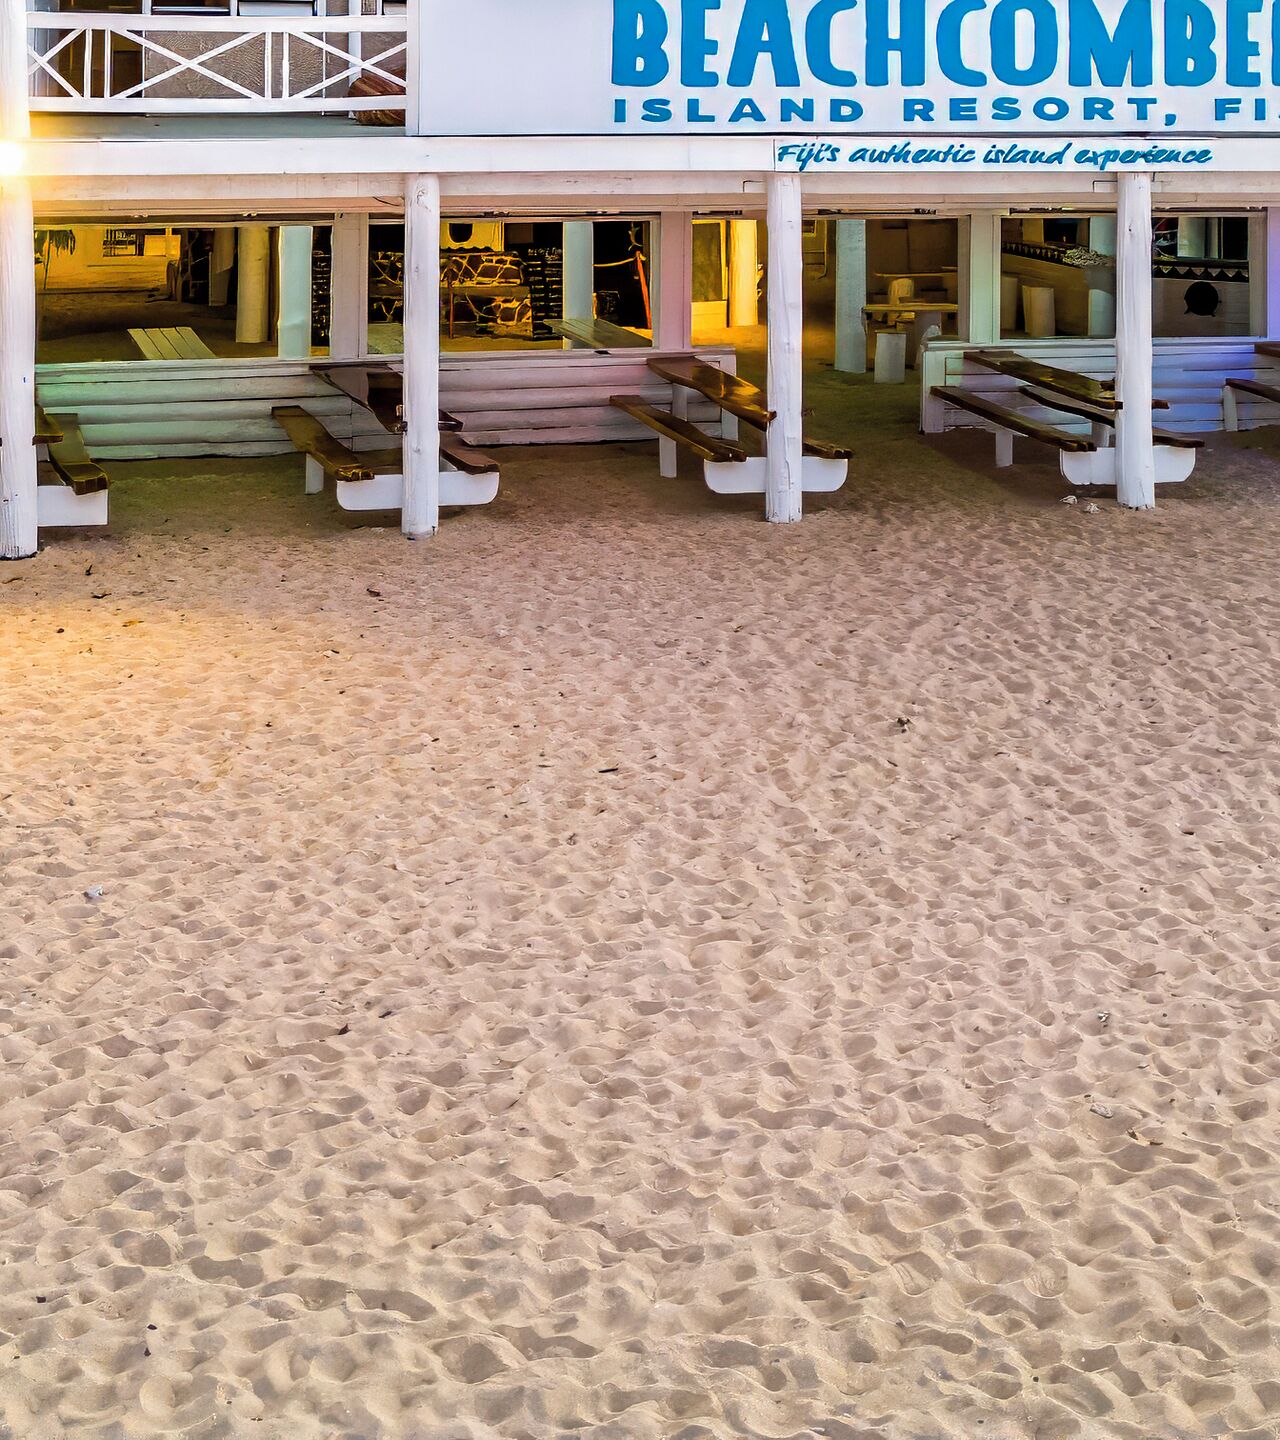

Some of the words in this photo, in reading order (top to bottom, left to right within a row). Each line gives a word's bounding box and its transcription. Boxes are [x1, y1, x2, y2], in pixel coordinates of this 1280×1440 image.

[614, 98, 864, 123] ISLAND
[904, 98, 1176, 126] RESORT,
[777, 143, 840, 172] Fiji's
[848, 141, 976, 164] authentic
[983, 143, 1071, 164] island
[1074, 147, 1212, 171] experience
